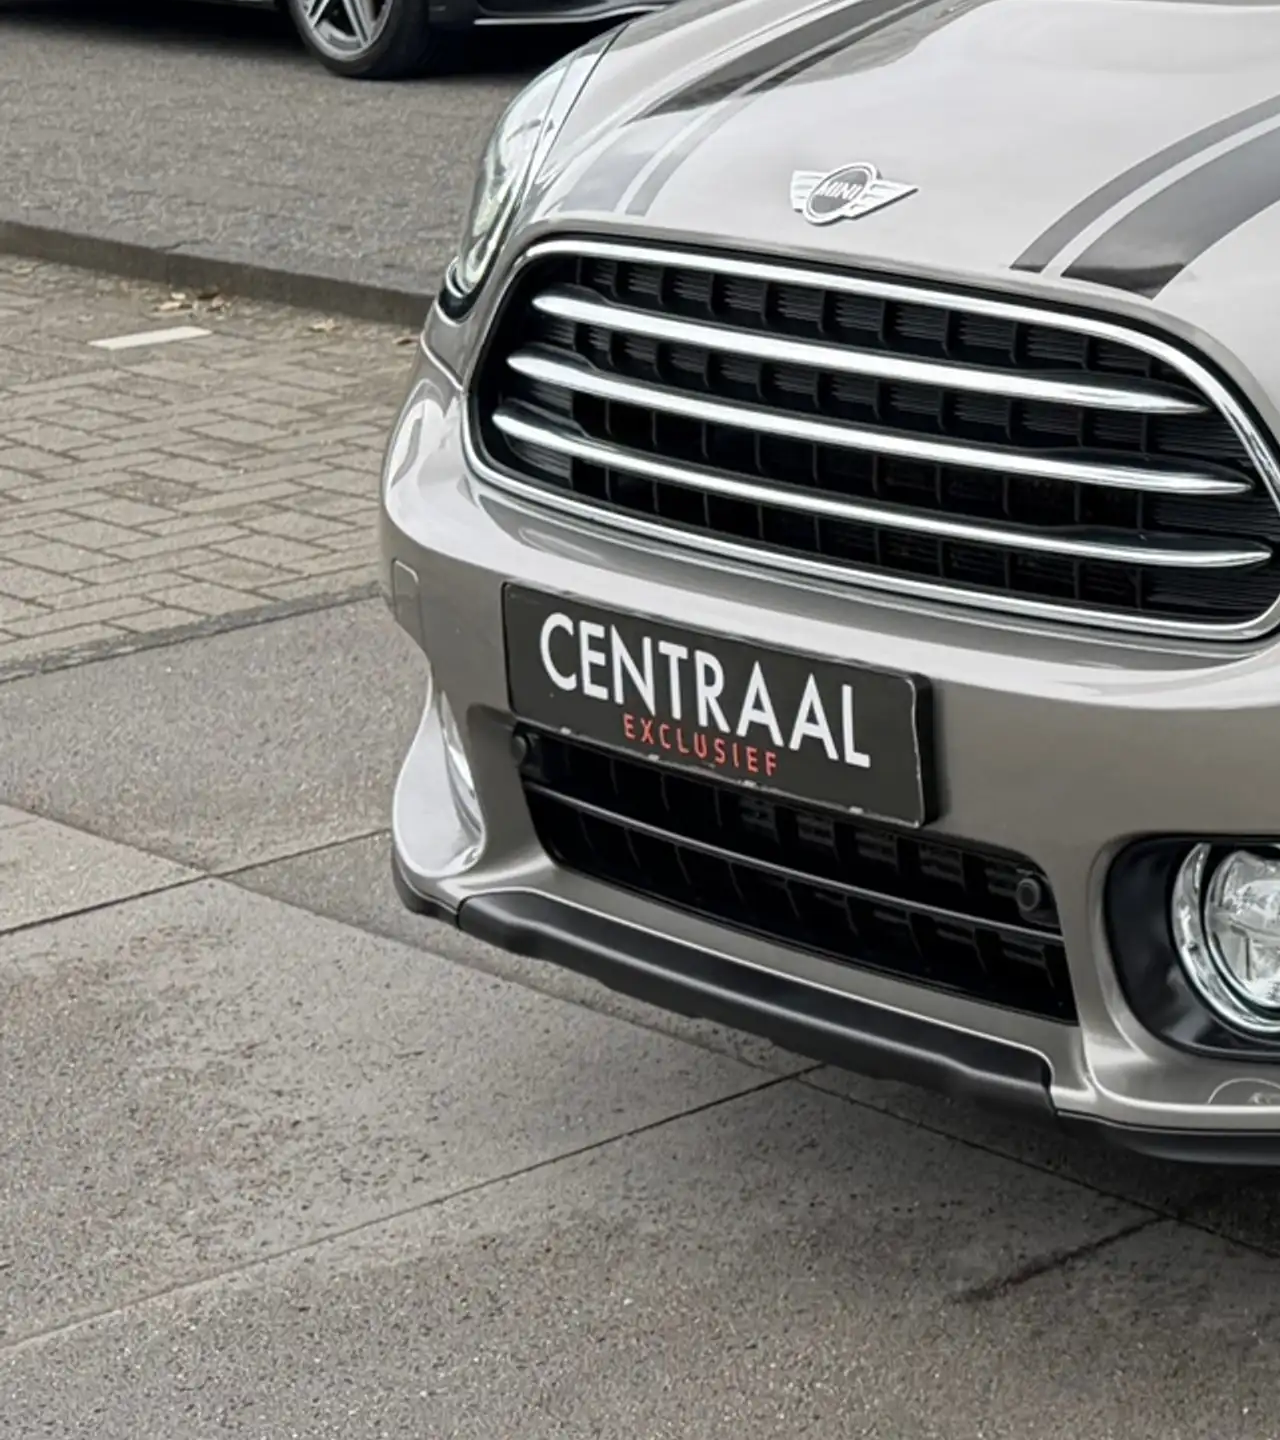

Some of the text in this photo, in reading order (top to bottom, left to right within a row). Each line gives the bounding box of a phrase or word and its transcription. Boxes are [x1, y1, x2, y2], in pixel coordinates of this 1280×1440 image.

[821, 181, 864, 200] MINI
[540, 612, 871, 768] CENTRAAL
[623, 712, 778, 776] EXCLUSIEF
